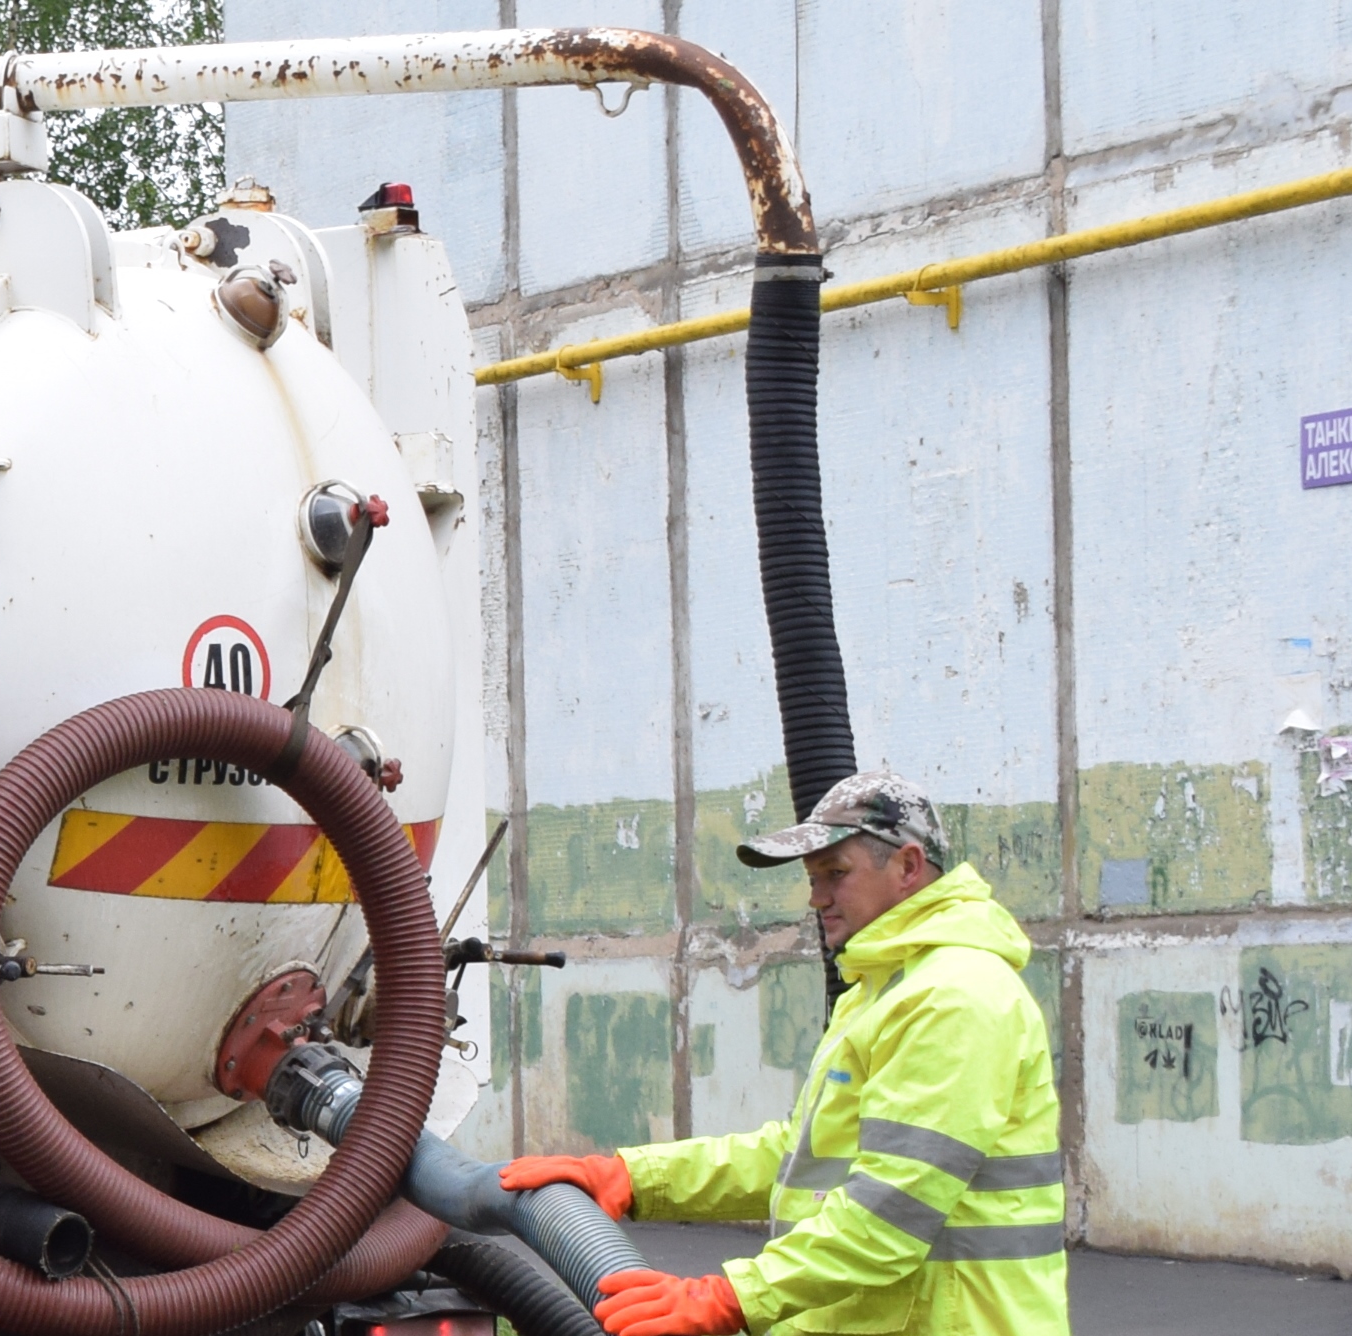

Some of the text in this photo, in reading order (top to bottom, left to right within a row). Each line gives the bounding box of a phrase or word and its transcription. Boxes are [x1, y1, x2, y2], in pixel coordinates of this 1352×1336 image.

[1304, 416, 1352, 449] ТАНК
[1305, 448, 1352, 481] АЛЕК
[203, 642, 253, 697] 40
